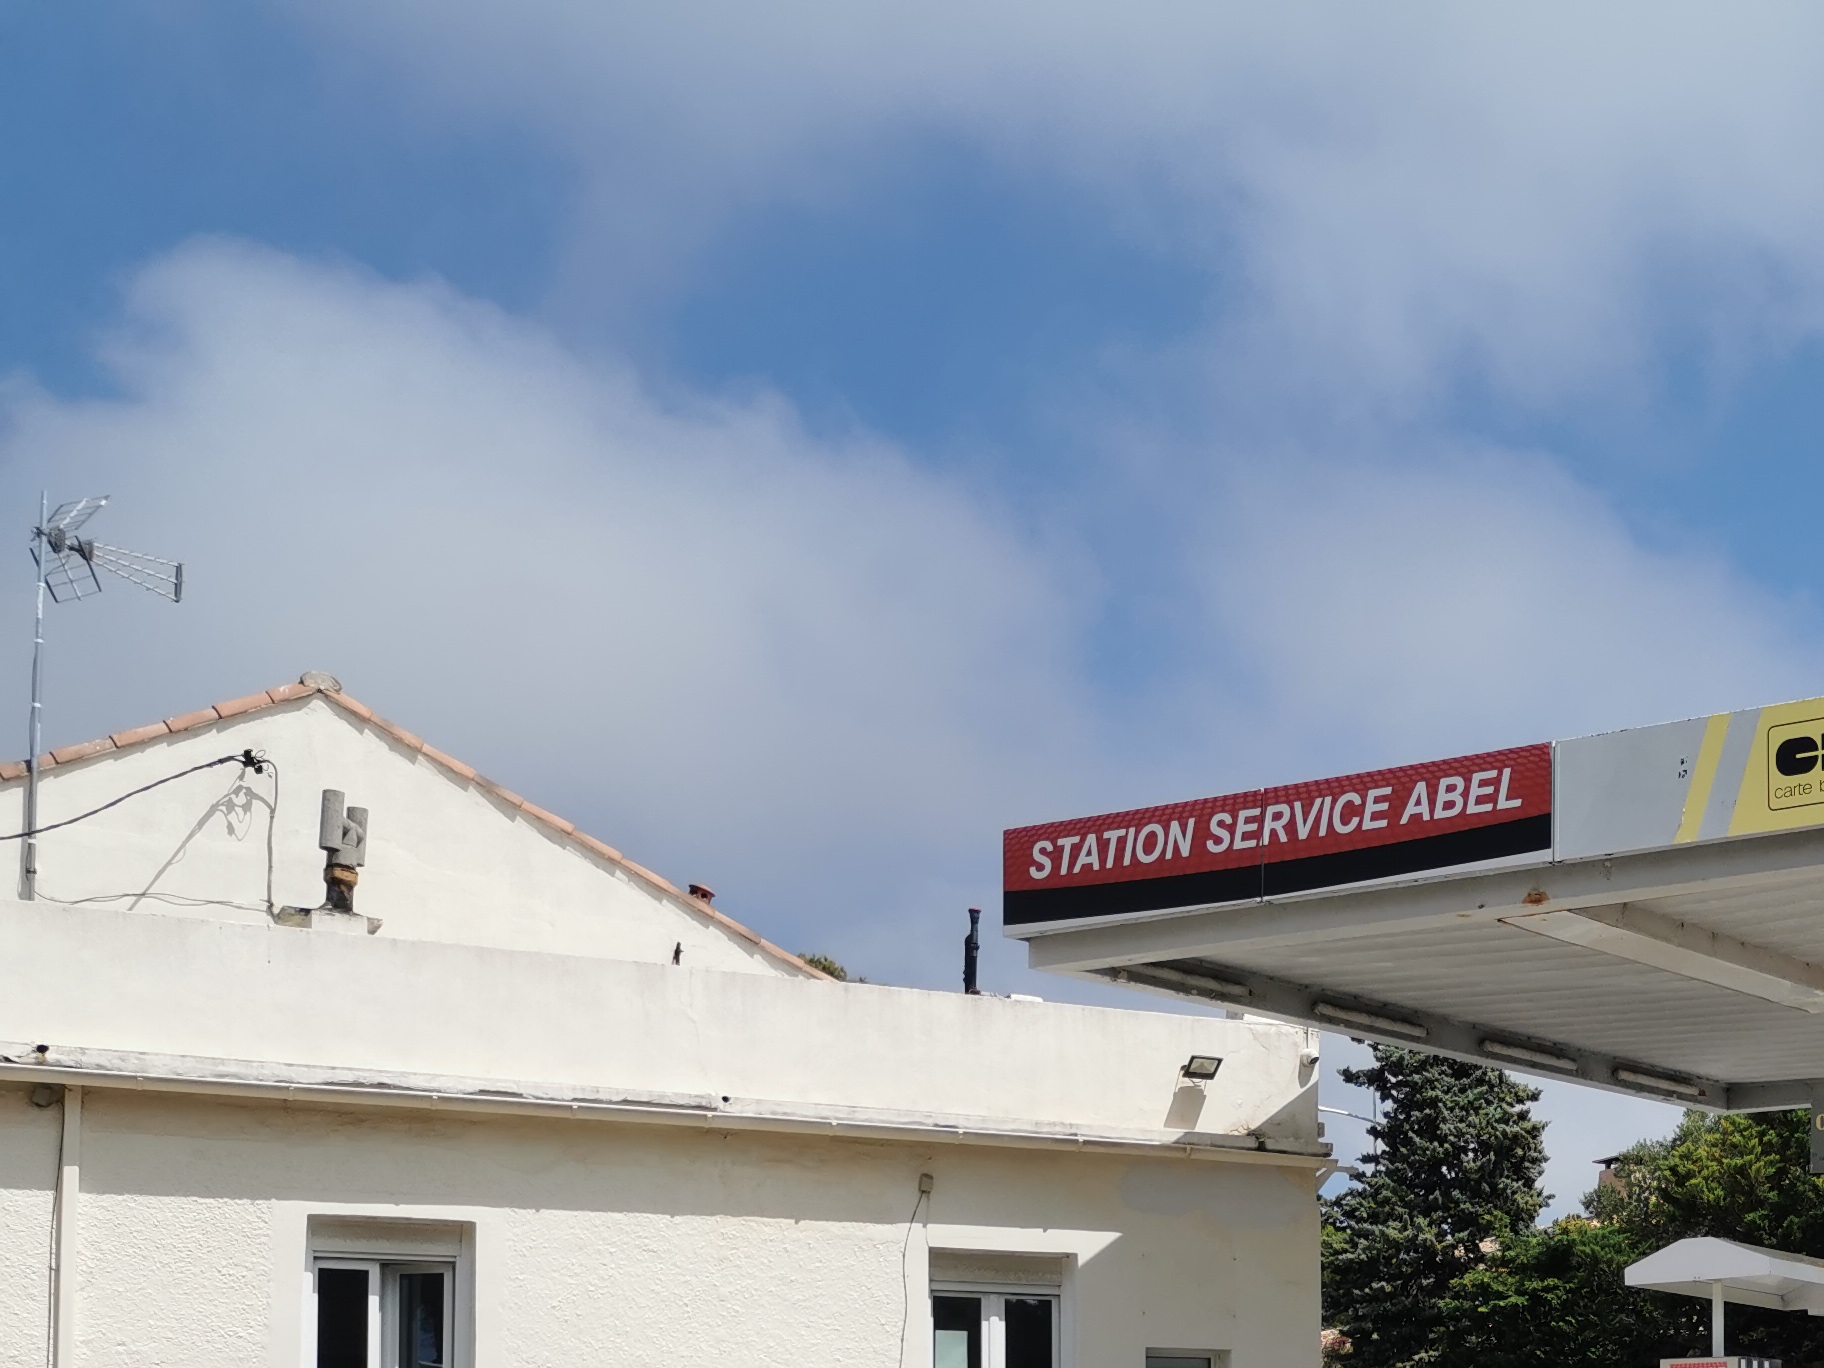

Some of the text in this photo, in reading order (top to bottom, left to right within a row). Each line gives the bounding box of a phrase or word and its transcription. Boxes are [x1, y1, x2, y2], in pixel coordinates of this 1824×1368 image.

[1029, 767, 1523, 880] STATION SERVICE ABEL
[1774, 781, 1813, 800] carte
